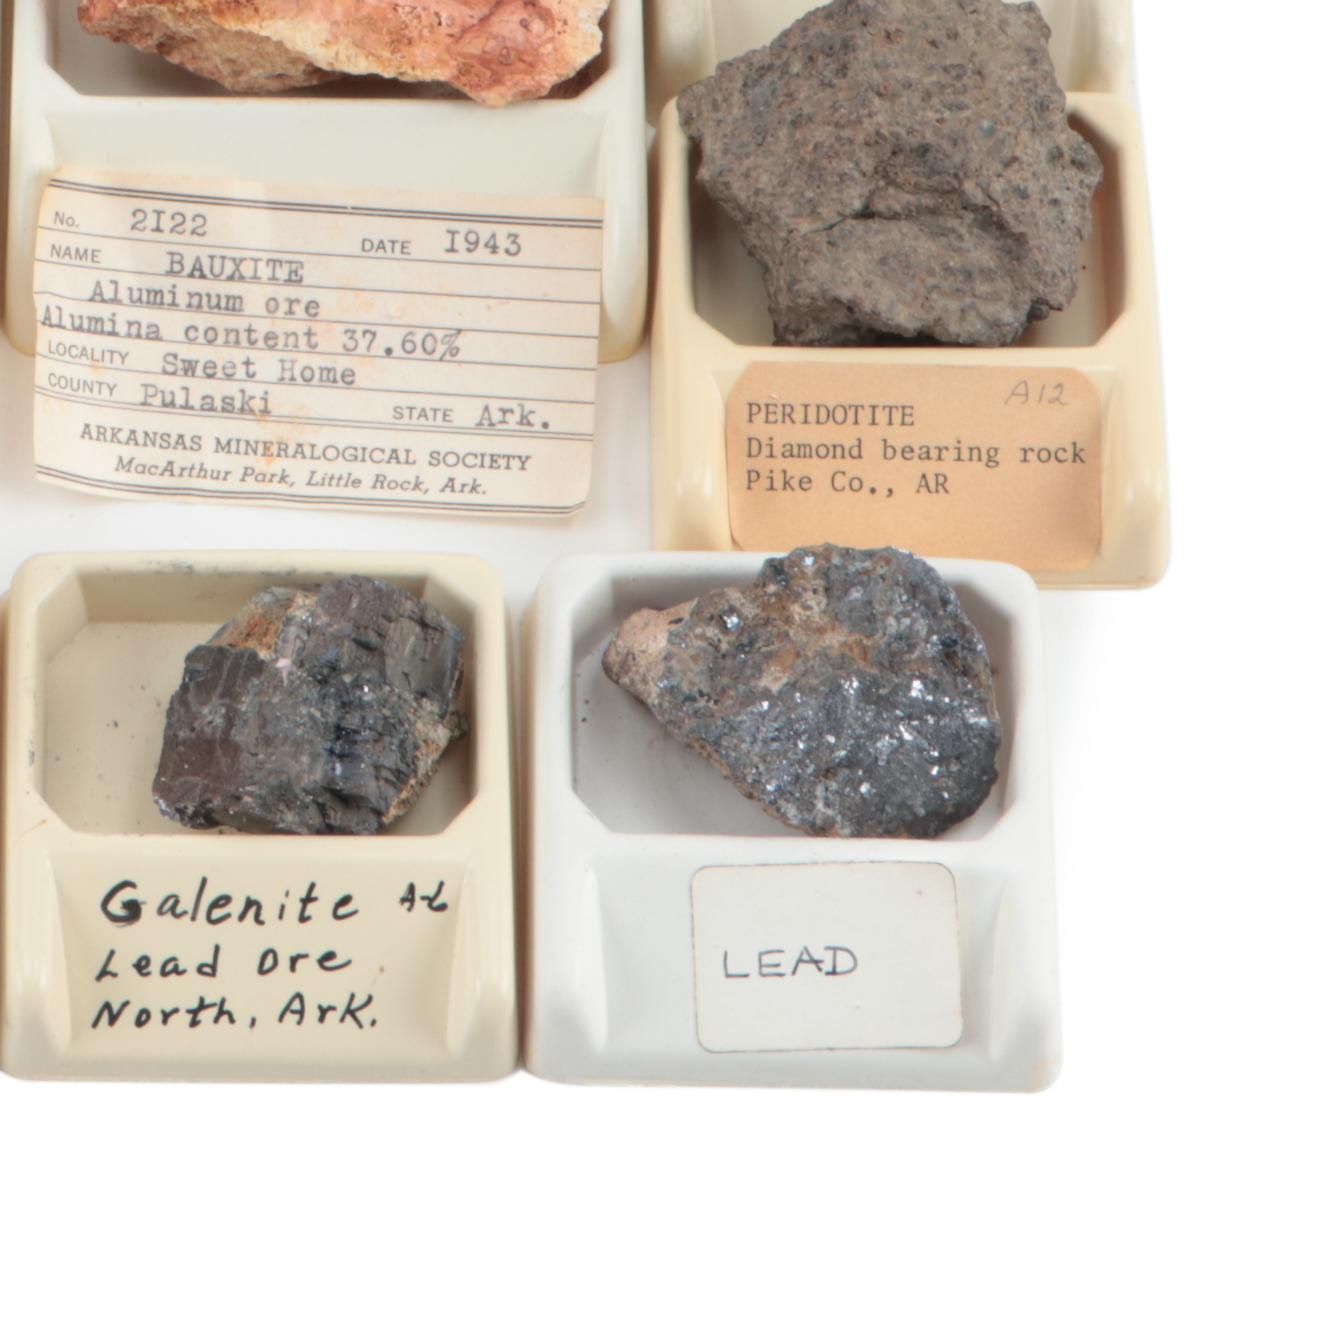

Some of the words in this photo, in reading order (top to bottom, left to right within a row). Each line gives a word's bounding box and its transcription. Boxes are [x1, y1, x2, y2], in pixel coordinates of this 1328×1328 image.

[53, 210, 80, 229] No.
[360, 237, 412, 256] DATE
[50, 243, 102, 264] NAME
[165, 250, 305, 285] BAUXITE
[89, 280, 245, 314] Aluminum
[264, 295, 322, 319] ore
[40, 306, 163, 343] Alumina
[184, 322, 320, 351] content
[342, 328, 463, 362] 37.60%
[47, 339, 130, 367] LOCALITY
[161, 352, 257, 380] Sweet
[278, 358, 357, 386] Home
[47, 372, 119, 398] COUNTY
[139, 383, 273, 416] Pulaski
[392, 405, 454, 424] STATE
[474, 402, 553, 431] Ark.
[746, 401, 915, 427] PERIDOTITE
[1003, 379, 1069, 406] A12
[79, 422, 203, 453] ARKANSAS
[214, 436, 418, 467] MINERALOGICAL
[427, 449, 533, 473] SOCIETY
[746, 436, 864, 460] Diamond
[880, 438, 1000, 468] bearing
[1018, 442, 1087, 465] rock
[114, 455, 232, 484] MacArthur
[241, 465, 297, 487] Park,
[306, 470, 363, 490] Little
[372, 474, 432, 496] Rock,
[439, 476, 488, 496] Ark.
[745, 469, 813, 492] Pike
[830, 471, 895, 498] Co.,
[915, 473, 950, 495] AR
[100, 876, 360, 928] Galenite
[95, 943, 221, 982] Lead
[256, 947, 353, 977] Ore
[722, 945, 858, 979] LEAD
[91, 995, 257, 1030] North,
